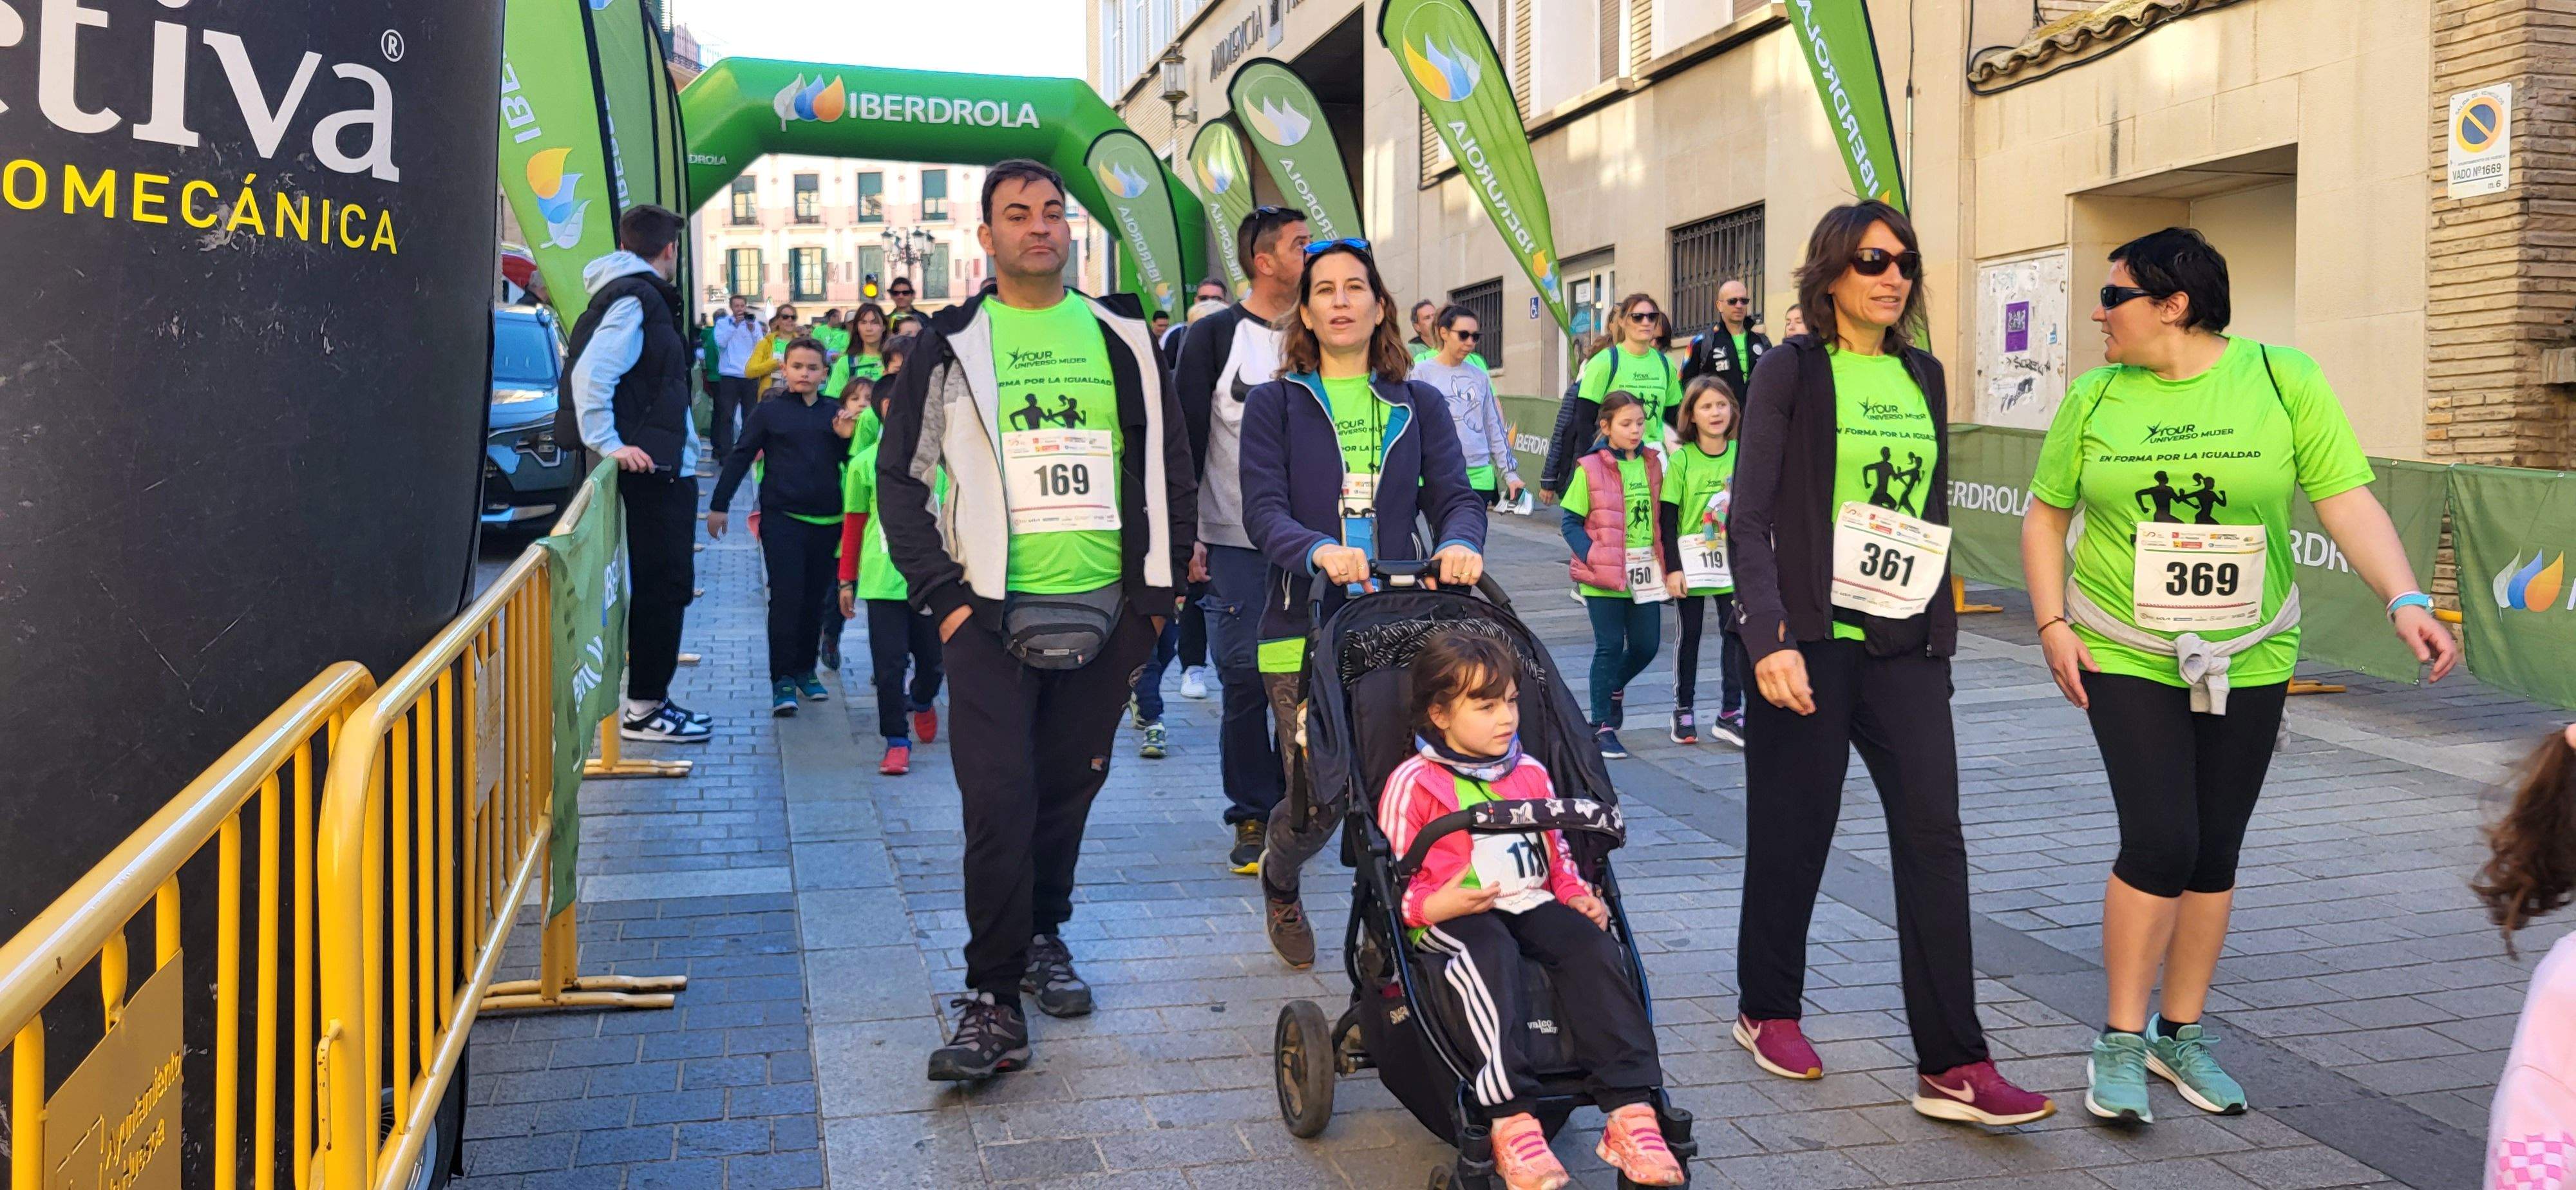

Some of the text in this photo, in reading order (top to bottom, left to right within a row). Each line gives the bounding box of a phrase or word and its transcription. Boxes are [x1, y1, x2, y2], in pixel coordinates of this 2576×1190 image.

[849, 91, 1041, 129] IBERDROLA
[2452, 168, 2472, 180] VADO
[2, 160, 399, 255] OMECÁNICA
[1014, 359, 1057, 370] UNIVERSO
[1065, 377, 1112, 386] IGUALDAD
[1844, 428, 1877, 436] FORMA
[2150, 428, 2234, 444] UNIVERSO MUJER
[2159, 424, 2195, 435] TOUR
[1513, 433, 1549, 457] IBERDR
[2201, 451, 2262, 459] IGUALDAD
[1034, 464, 1090, 496] 169
[1698, 551, 1723, 569] 119
[1860, 542, 1915, 587] 361
[1627, 566, 1651, 585] 150
[2166, 562, 2239, 596] 369
[1527, 1019, 1553, 1030] valco
[1540, 1026, 1558, 1035] baby
[106, 1051, 181, 1171] Ayuntamiento
